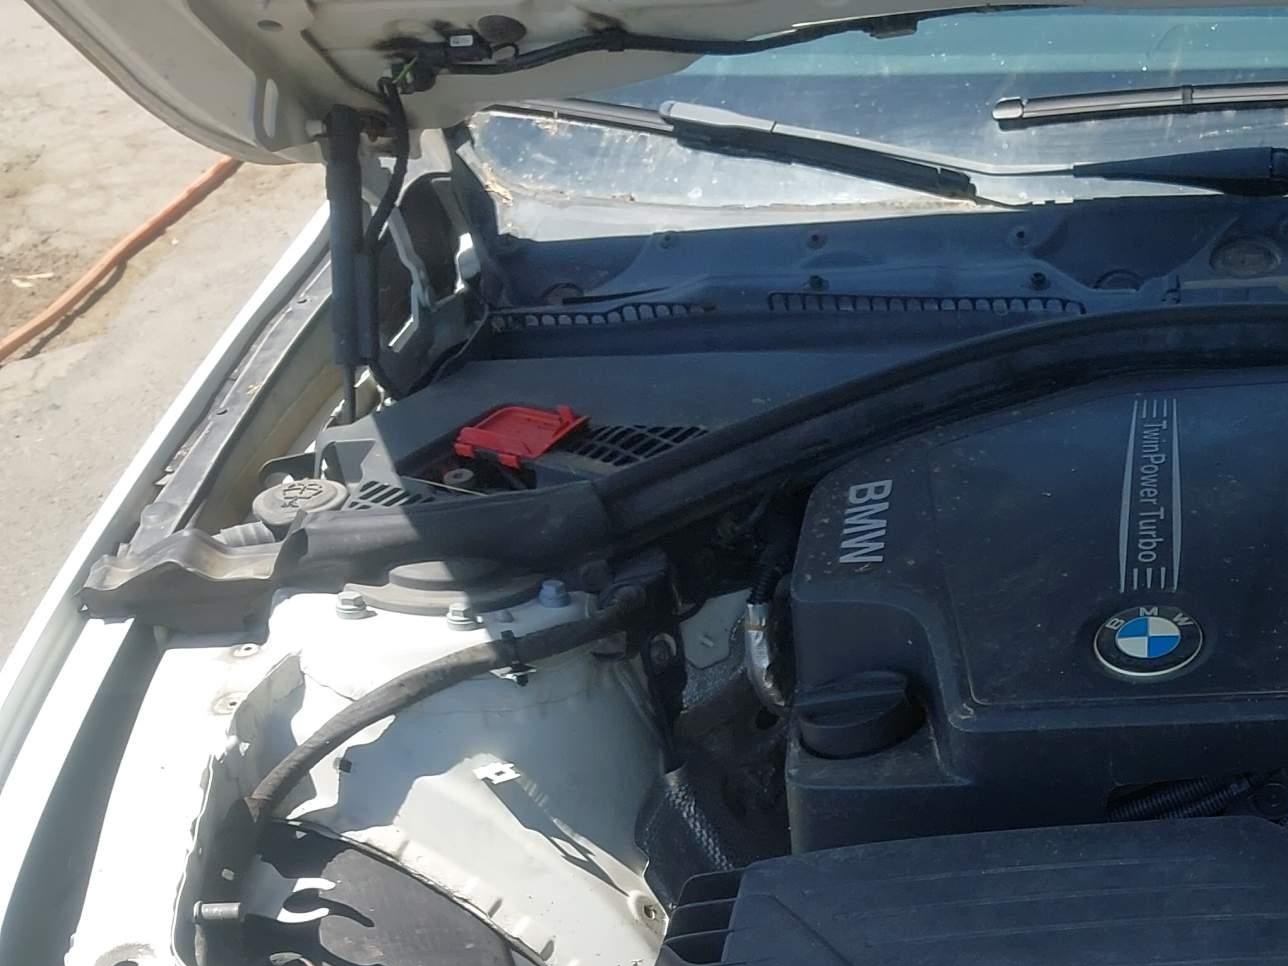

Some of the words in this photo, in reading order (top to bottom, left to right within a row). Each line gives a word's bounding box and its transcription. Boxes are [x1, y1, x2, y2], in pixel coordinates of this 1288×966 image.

[1139, 419, 1168, 503] TwinPower
[839, 480, 893, 564] BMW
[1137, 506, 1165, 562] Turbo
[1105, 606, 1194, 631] BMW
